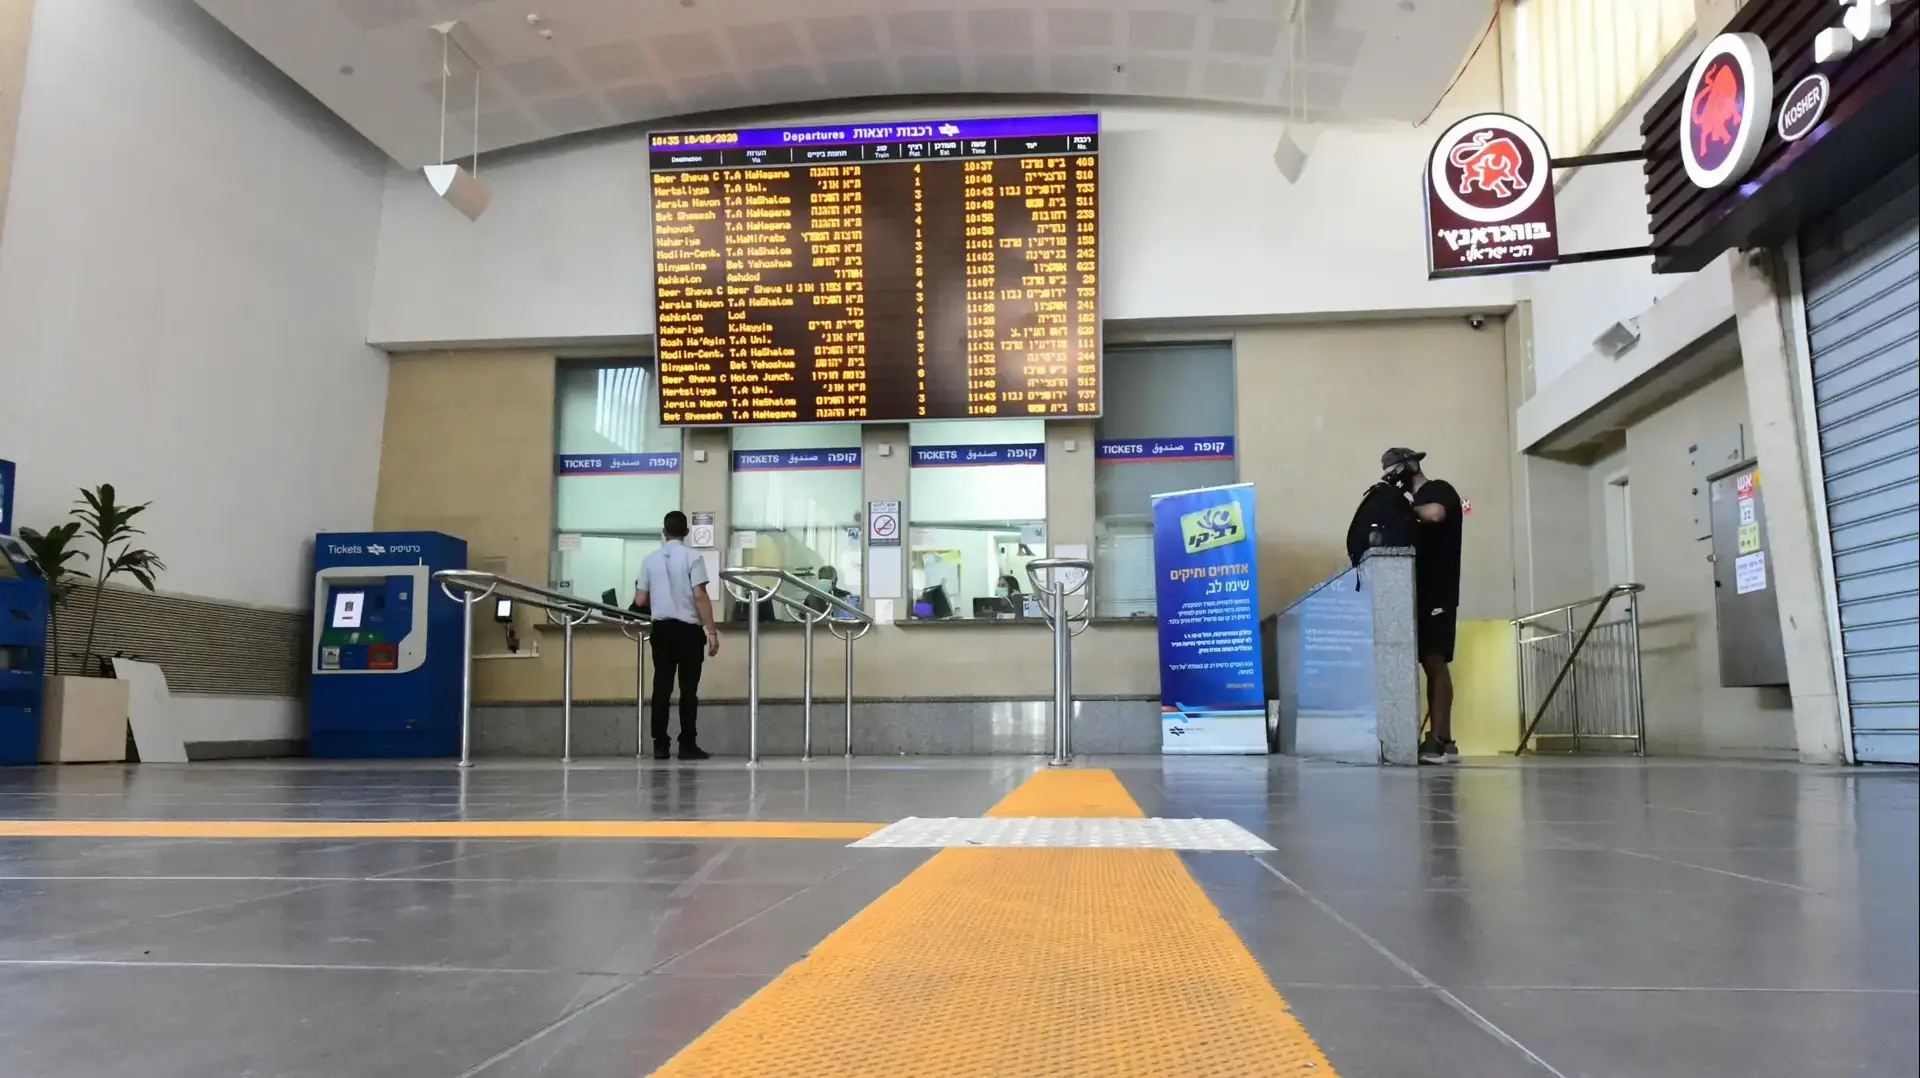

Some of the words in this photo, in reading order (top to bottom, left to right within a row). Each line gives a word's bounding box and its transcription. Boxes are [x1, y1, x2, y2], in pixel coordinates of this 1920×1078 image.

[1784, 86, 1821, 129] KOSHER
[783, 131, 845, 143] Departures
[853, 127, 893, 139] יוצאות
[896, 126, 932, 138] רכבות
[652, 135, 680, 146] 10:35
[671, 155, 703, 163] Destination
[1076, 157, 1095, 167] 409
[965, 161, 993, 172] 10:37
[654, 174, 677, 184] Beer
[681, 173, 709, 183] Sheva
[713, 171, 720, 181] C
[745, 170, 790, 180] HaHagana
[965, 174, 993, 185] 10:40
[1076, 170, 1094, 180] 510
[745, 183, 767, 193] Uni.
[965, 187, 994, 198] 10:43
[1076, 183, 1095, 193] 733
[692, 198, 721, 207] Navon
[746, 195, 791, 205] HaShalom
[1076, 196, 1094, 206] 511
[966, 200, 994, 211] 10:49
[656, 212, 673, 222] Bet
[677, 211, 716, 220] Shemesh
[747, 209, 791, 218] HaHagana
[656, 225, 694, 234] Rehovot
[747, 221, 792, 231] HaHagana
[1077, 222, 1094, 233] 110
[657, 237, 701, 247] Nahariya
[966, 239, 993, 249] 11:01
[748, 247, 792, 256] HaShalom
[1077, 248, 1095, 258] 242
[1460, 245, 1507, 263] ישראלי.
[1509, 244, 1533, 258] הכי
[967, 252, 994, 262] 11:02
[658, 263, 707, 272] Binyamina
[726, 260, 744, 270] Bet
[748, 260, 792, 268] Yehoshua
[967, 265, 995, 275] 11:03
[658, 275, 702, 285] Ashkelon
[727, 272, 760, 282] Ashdod
[967, 277, 995, 288] 11:07
[658, 288, 681, 297] Beer
[685, 287, 713, 296] Sheva
[716, 286, 724, 295] C
[727, 286, 750, 295] Beer
[754, 285, 783, 294] Sheva
[786, 284, 793, 293] U
[967, 291, 995, 300] 11:12
[696, 299, 724, 309] Navon
[749, 297, 794, 307] HaShalom
[1078, 301, 1094, 310] 241
[659, 313, 703, 322] Ashkelon
[728, 310, 746, 320] Lod
[660, 325, 704, 335] Nahariya
[729, 323, 773, 333] K.Hayyim
[660, 338, 684, 347] Rosh
[750, 335, 772, 345] Uni.
[750, 347, 795, 357] HaShalom
[968, 342, 994, 353] 11:31
[968, 354, 995, 365] 11:32
[661, 362, 711, 373] Binyamina
[730, 360, 748, 370] Bet
[751, 360, 796, 369] Yehoshua
[730, 373, 759, 382] Holon
[763, 372, 794, 382] Junct.
[968, 367, 996, 377] 11:33
[662, 375, 685, 385] Beer
[688, 375, 717, 384] Sheva
[720, 374, 727, 383] C
[968, 380, 995, 389] 11:40
[1078, 378, 1096, 386] 512
[752, 385, 773, 394] Uni.
[1078, 390, 1096, 399] 737
[752, 397, 797, 407] HaShalom
[968, 392, 996, 402] 11:43
[699, 400, 728, 408] Navon
[1078, 403, 1096, 412] 513
[753, 410, 797, 419] HaHagana
[968, 405, 997, 414] 11:49
[663, 412, 681, 421] Bet
[685, 412, 723, 421] Shemesh
[1102, 444, 1143, 455] TICKETS
[1151, 443, 1184, 456] صندوق
[1194, 441, 1225, 454] קופה
[787, 452, 819, 465] صندوق
[828, 452, 857, 464] קופה
[918, 450, 957, 461] TICKETS
[965, 449, 998, 462] صندوق
[1007, 448, 1038, 460] קופה
[564, 458, 601, 469] TICKETS
[610, 457, 641, 470] صندوق
[649, 457, 678, 469] קופה
[741, 454, 779, 465] TICKETS
[328, 544, 362, 555] Tickets
[390, 544, 421, 553] כרטיסים
[1169, 566, 1206, 582] ותיקים
[1208, 563, 1249, 577] אזרחים
[1206, 579, 1222, 595] לב,
[1225, 579, 1250, 592] שימו
